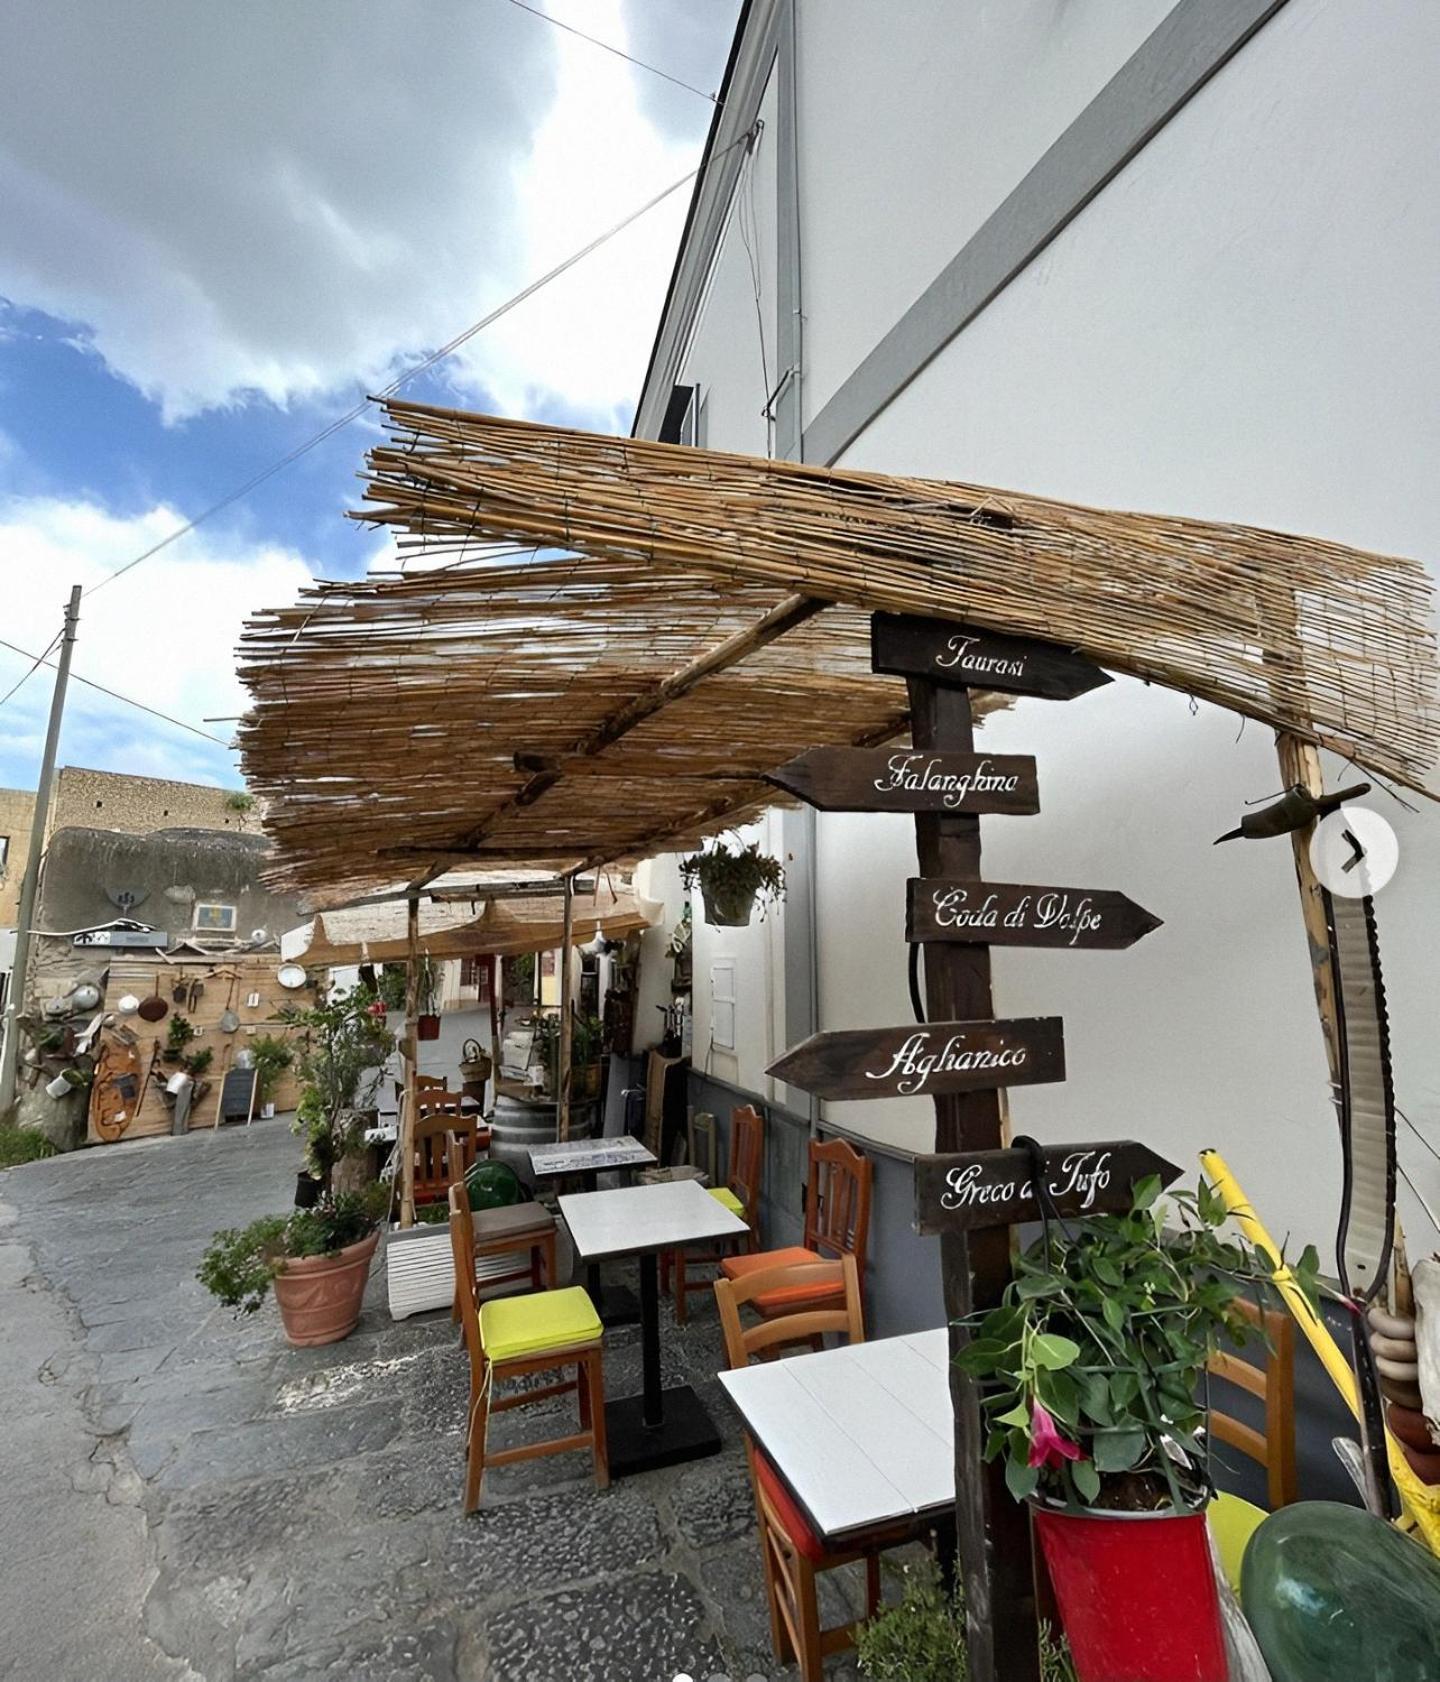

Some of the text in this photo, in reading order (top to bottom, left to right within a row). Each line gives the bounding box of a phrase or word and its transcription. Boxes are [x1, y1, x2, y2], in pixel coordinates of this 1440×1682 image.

[935, 635, 1027, 677] Taurasi
[873, 754, 1019, 808] Falanghina
[932, 888, 1102, 946] Coda di Volpe
[865, 1032, 1026, 1095] Aglianico
[940, 1164, 1015, 1210] Greco
[1050, 1151, 1112, 1208] Tufo
